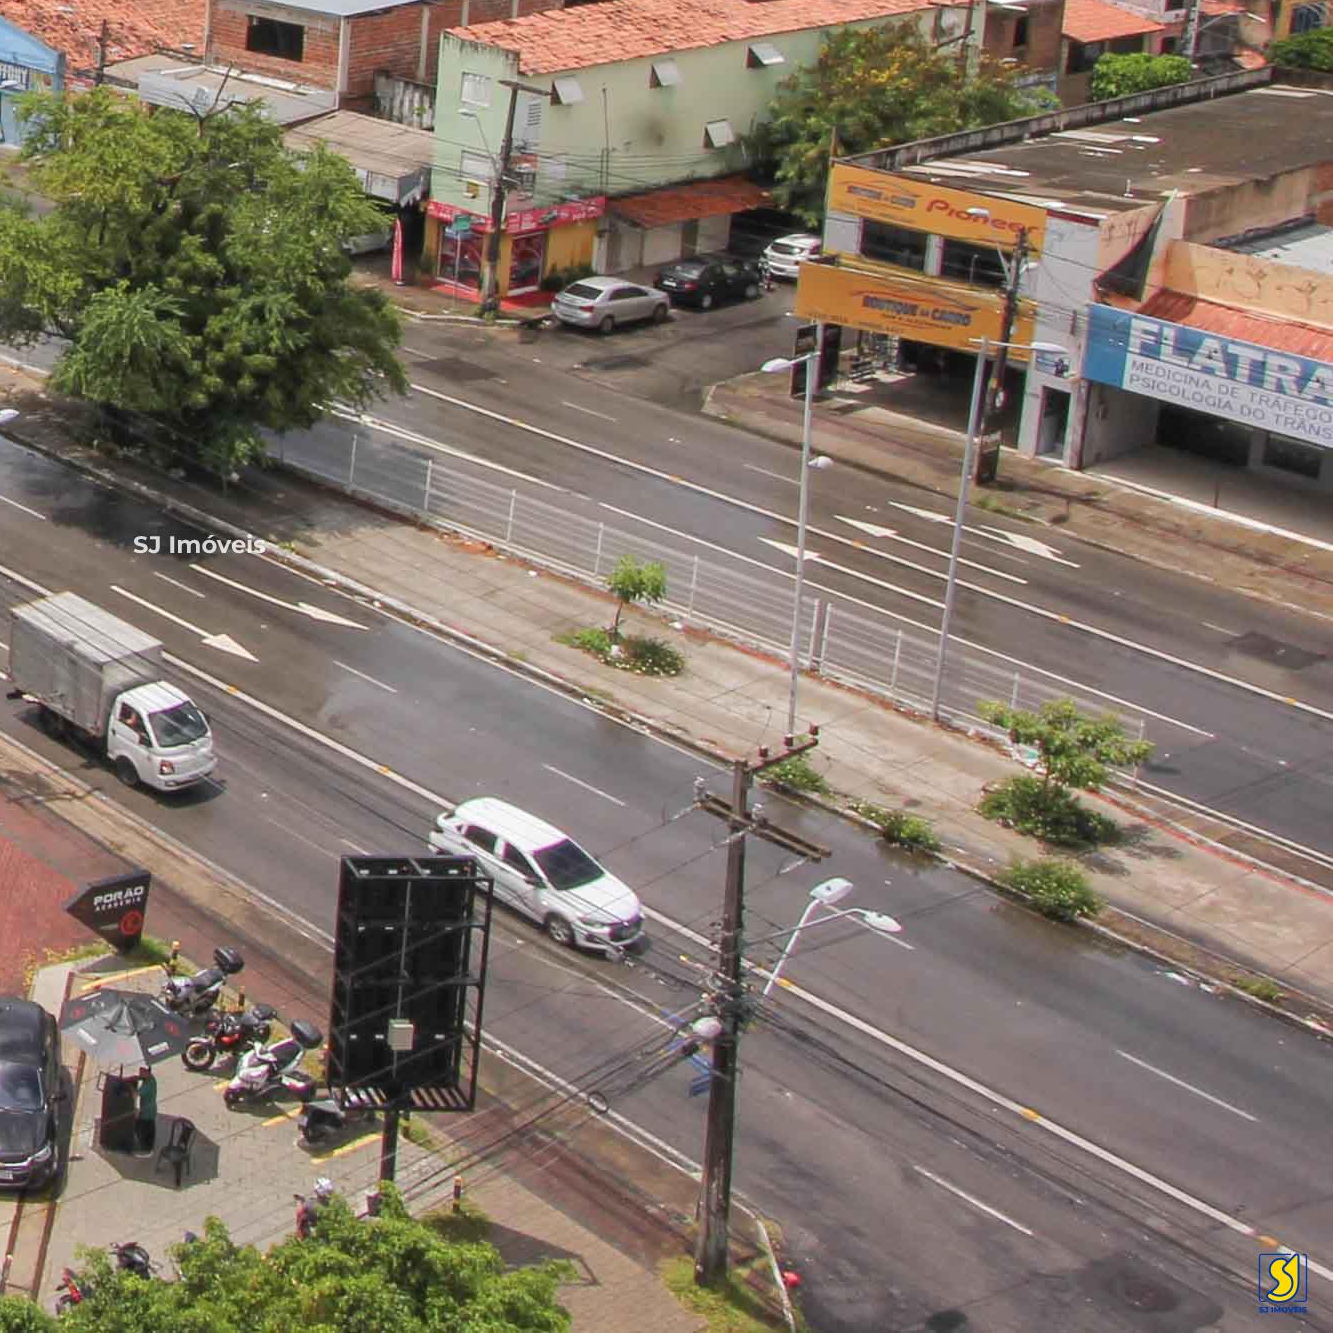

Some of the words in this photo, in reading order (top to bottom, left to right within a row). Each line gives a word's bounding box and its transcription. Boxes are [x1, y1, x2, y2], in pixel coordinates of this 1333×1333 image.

[926, 198, 1040, 234] Pioneer
[1129, 374, 1233, 414] PSICOLOGIA
[1239, 405, 1266, 422] DO
[1133, 360, 1213, 392] MEDICINA
[1217, 382, 1240, 398] DE
